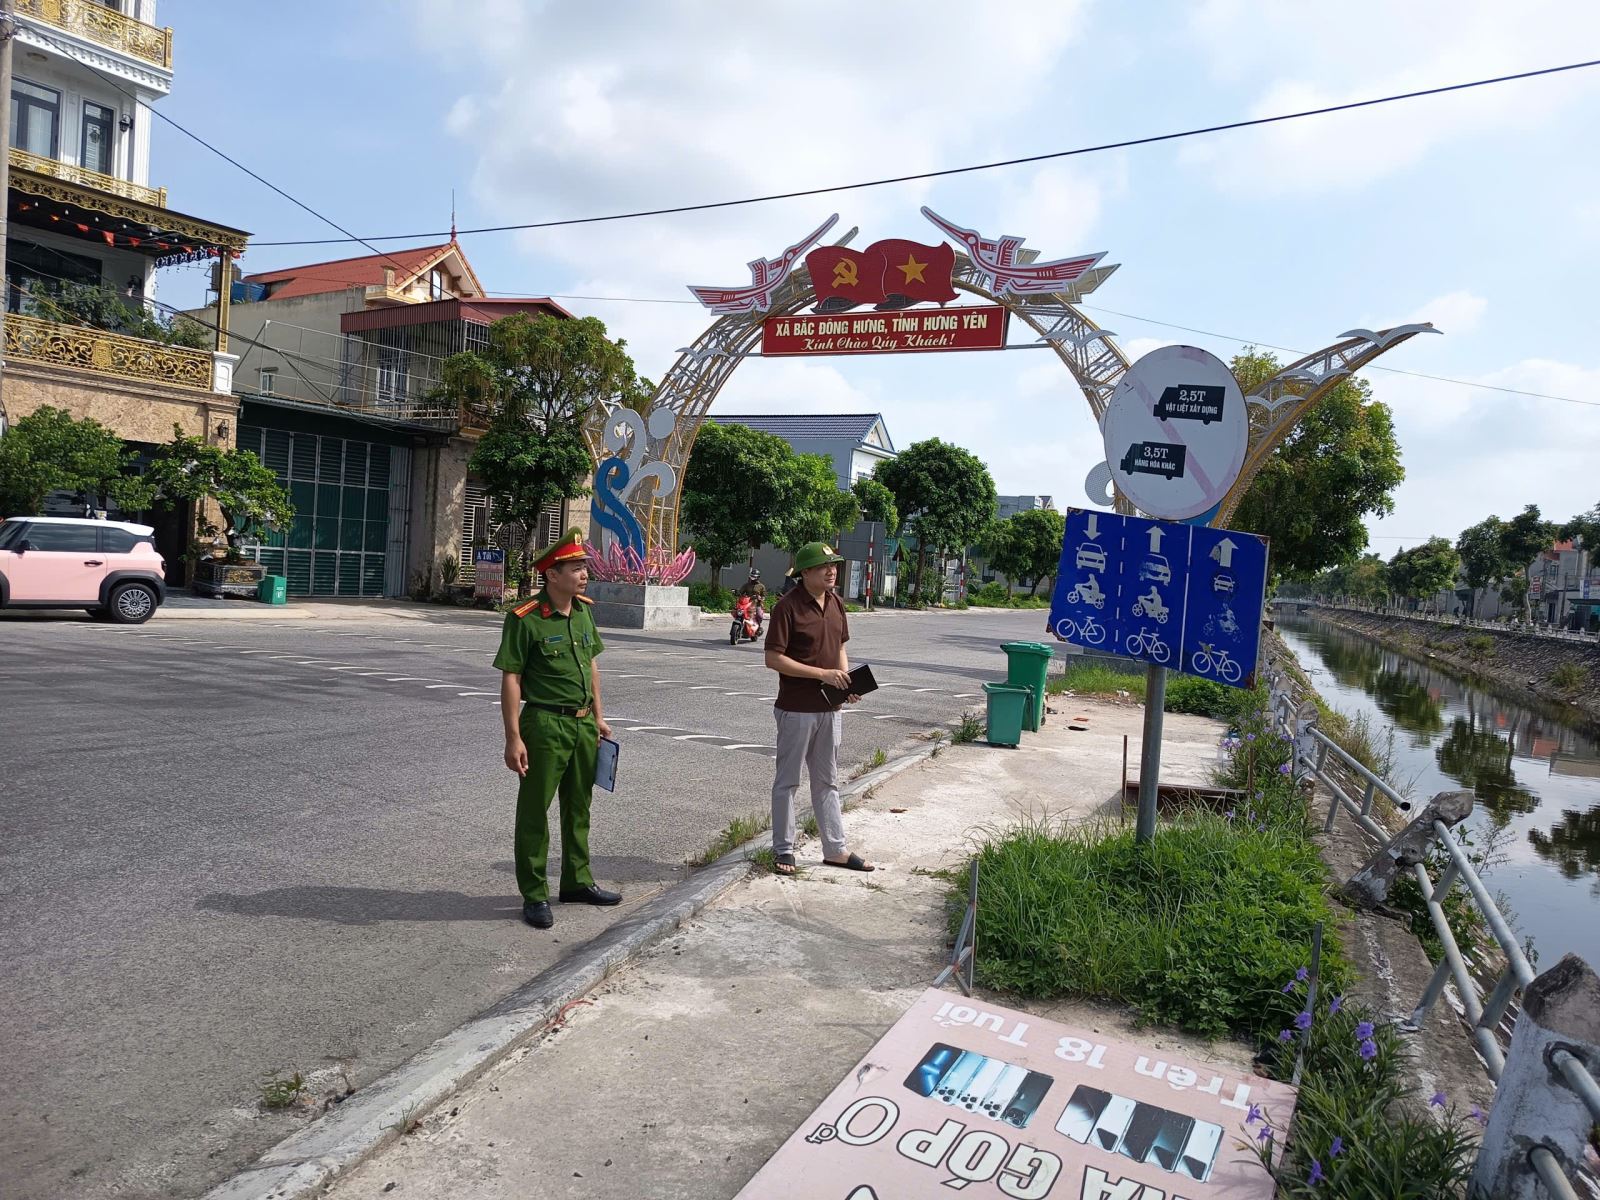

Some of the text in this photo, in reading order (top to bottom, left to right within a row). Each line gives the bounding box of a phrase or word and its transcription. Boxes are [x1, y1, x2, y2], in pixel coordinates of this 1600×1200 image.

[776, 311, 988, 337] XÃ BẮC ĐÔNG HƯNG, TỈNH HƯNG YÊN
[801, 338, 833, 350] Kính
[837, 337, 868, 348] Chào
[1179, 389, 1206, 403] 2,5T
[1144, 446, 1168, 459] 3,5T
[932, 1001, 1251, 1111] Trên 18 Tuổi
[896, 1118, 1063, 1200] GÓP
